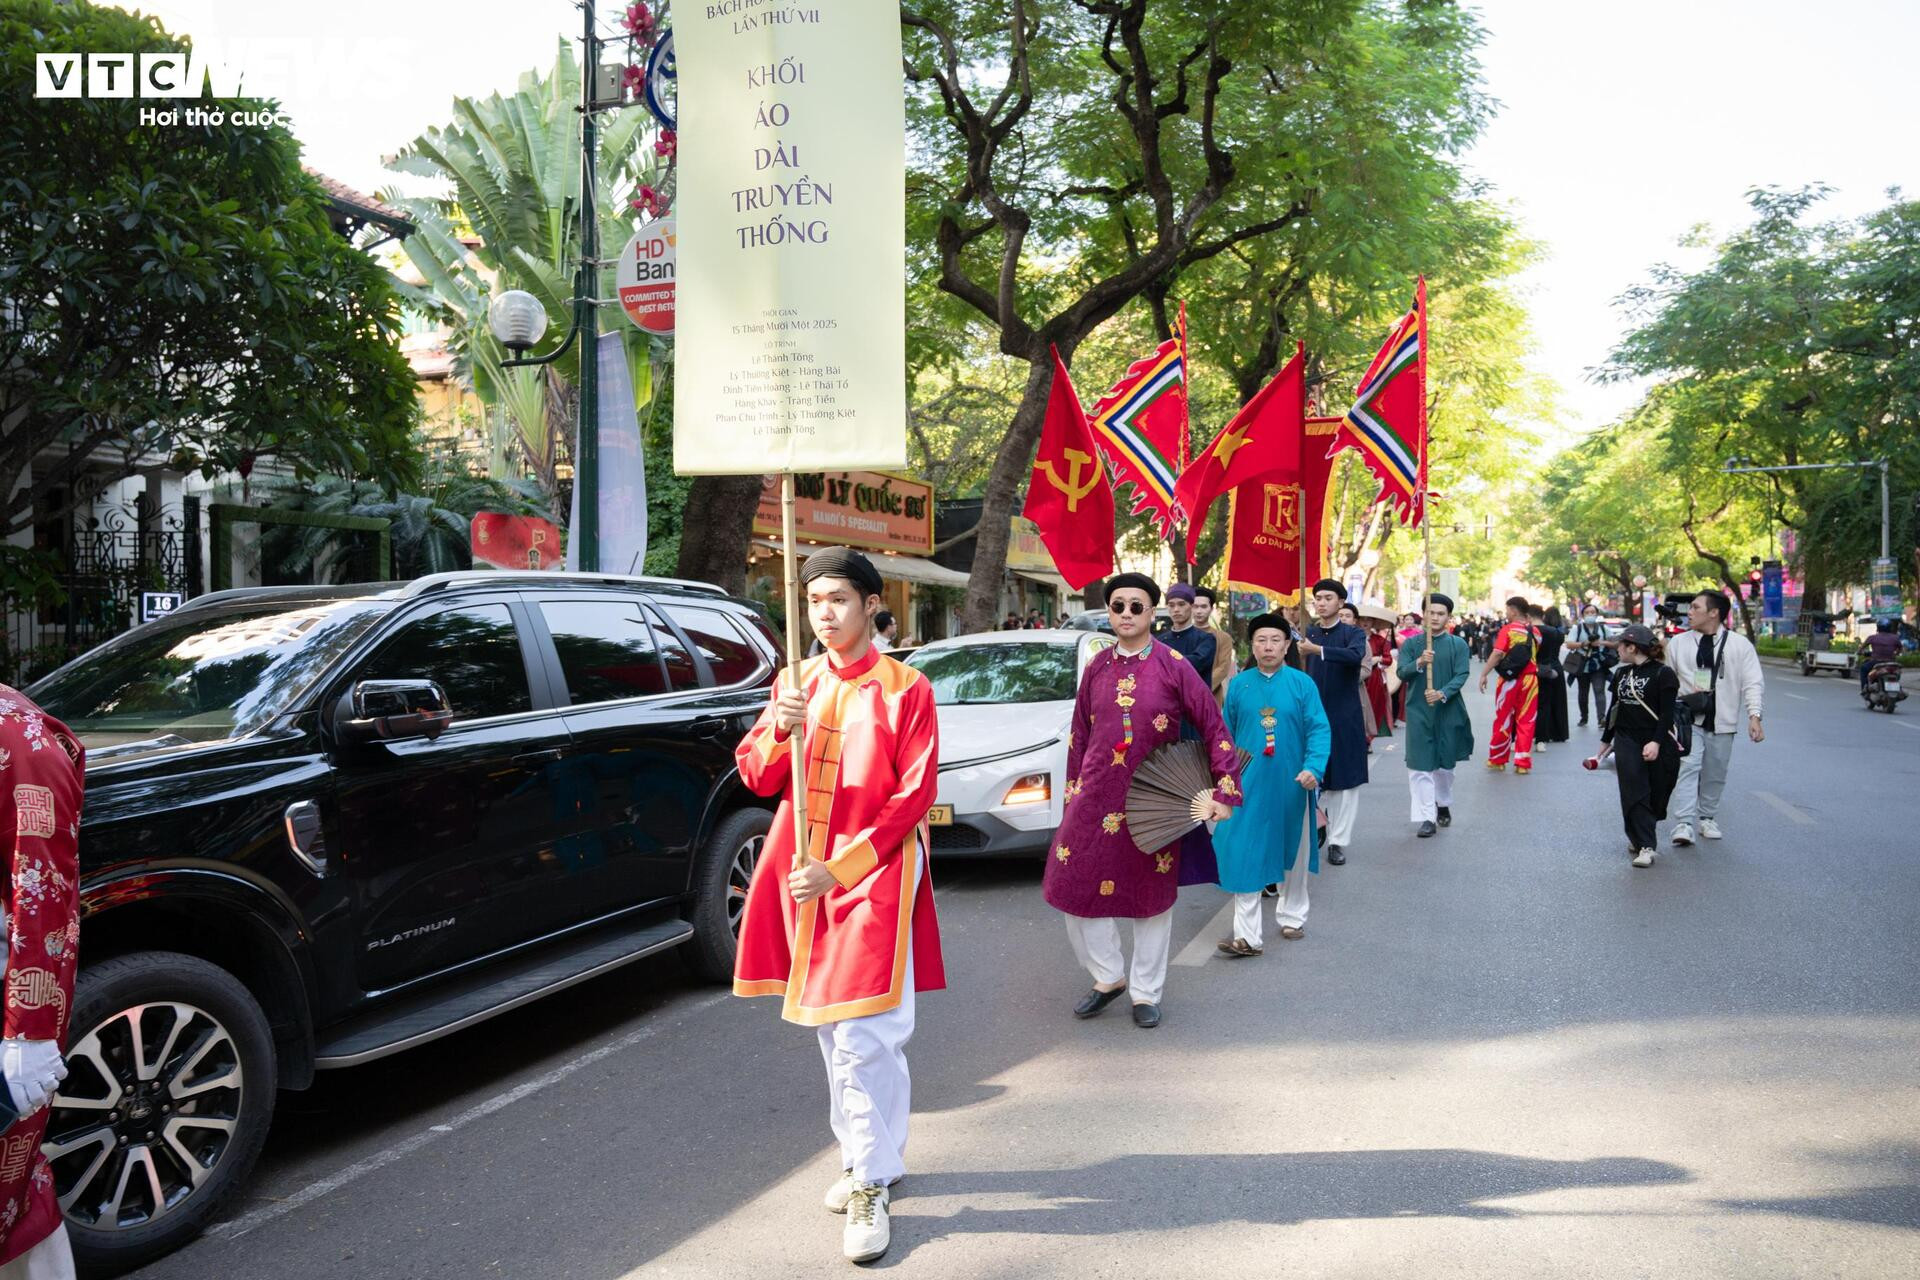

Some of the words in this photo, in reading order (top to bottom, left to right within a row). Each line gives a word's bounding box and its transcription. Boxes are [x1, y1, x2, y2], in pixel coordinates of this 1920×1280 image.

[761, 7, 795, 25] THỨ
[797, 10, 820, 23] VII
[747, 56, 805, 89] KHỐI
[754, 101, 790, 129] ÁO
[755, 140, 800, 170] DÀI
[732, 175, 832, 212] TRUYỀN
[736, 215, 829, 248] THỐNG
[636, 238, 665, 261] HD
[636, 257, 676, 281] Ban
[624, 290, 670, 304] COMMITTED
[638, 303, 657, 314] BEST
[657, 301, 676, 313] RETU
[812, 319, 838, 329] 2025
[1252, 534, 1267, 545] ÁO
[154, 597, 171, 611] 16
[367, 917, 456, 951] PLATINUM
